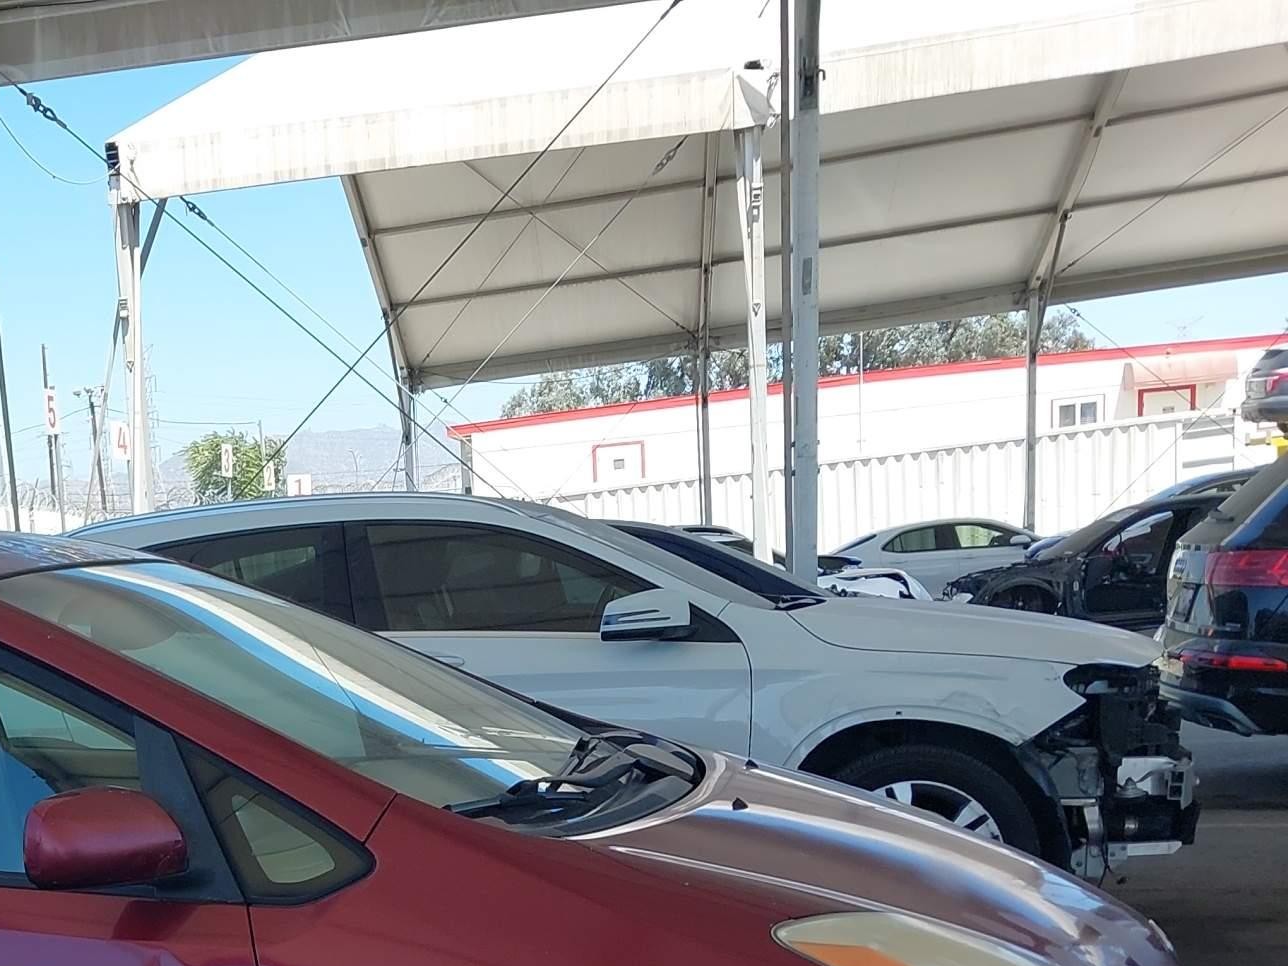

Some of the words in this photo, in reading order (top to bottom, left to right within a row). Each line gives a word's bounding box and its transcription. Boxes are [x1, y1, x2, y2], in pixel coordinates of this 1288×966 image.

[47, 395, 56, 429] 5
[118, 427, 128, 455] 4
[223, 448, 230, 473] 3
[266, 465, 272, 486] 2
[294, 478, 302, 496] 1
